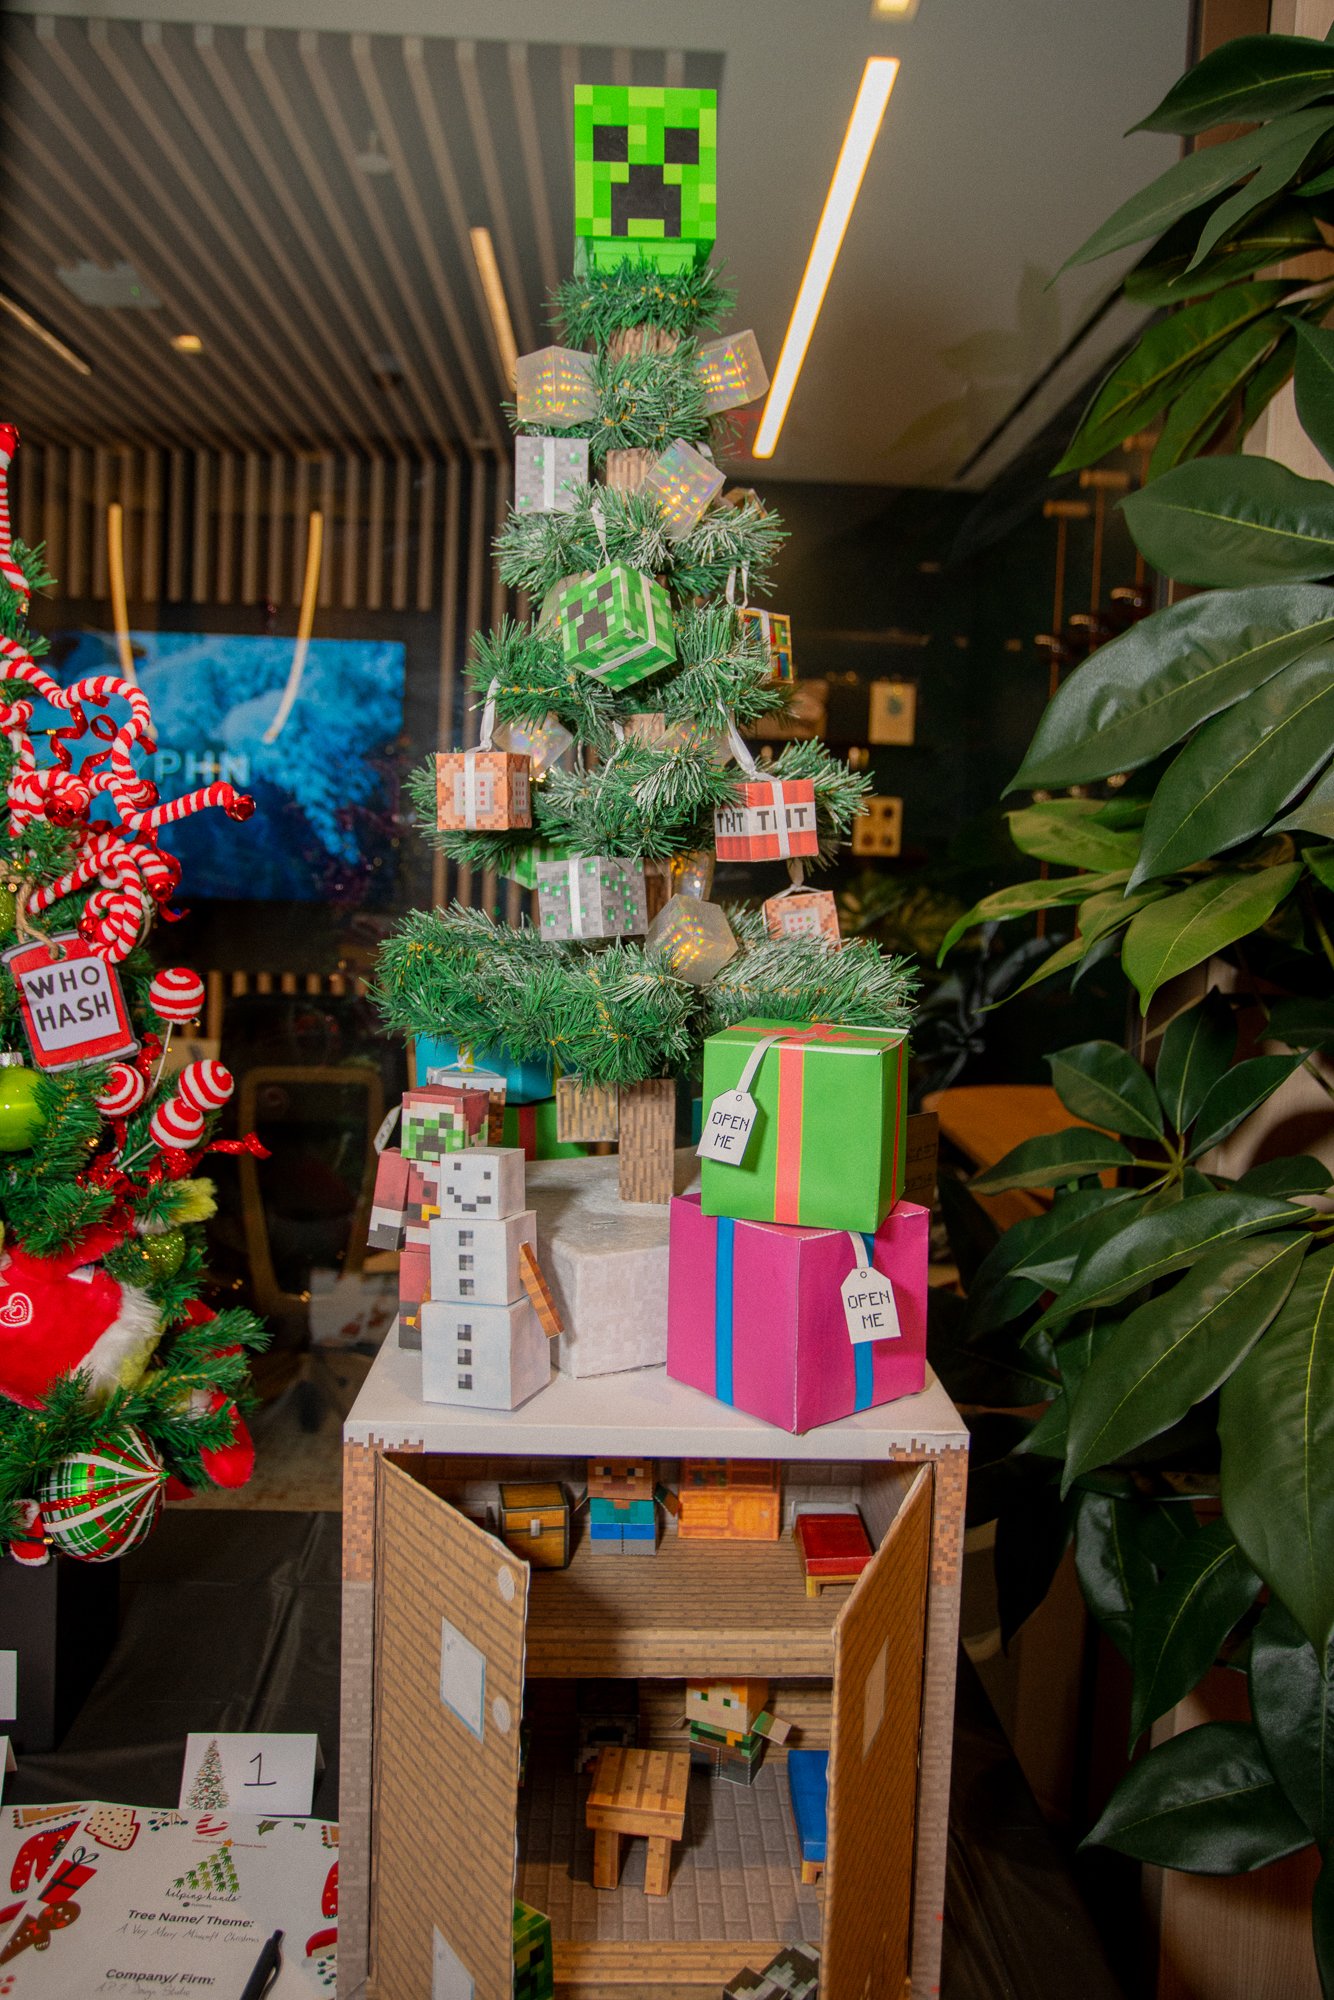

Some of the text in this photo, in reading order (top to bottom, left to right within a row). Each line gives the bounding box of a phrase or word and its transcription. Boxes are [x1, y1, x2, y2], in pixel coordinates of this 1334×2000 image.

[716, 812, 744, 833] TNT
[26, 965, 100, 999] WHO
[36, 991, 111, 1032] HASH
[711, 1111, 750, 1132] OPEN
[713, 1134, 735, 1150] ME
[847, 1290, 891, 1309] OPEN
[861, 1313, 885, 1329] ME
[243, 1752, 277, 1787] 1
[165, 1888, 205, 1902] helping
[128, 1909, 255, 1928] Tree Name/ Theme:
[115, 1923, 127, 1934] A
[105, 1969, 216, 1985] Company/ Firm:
